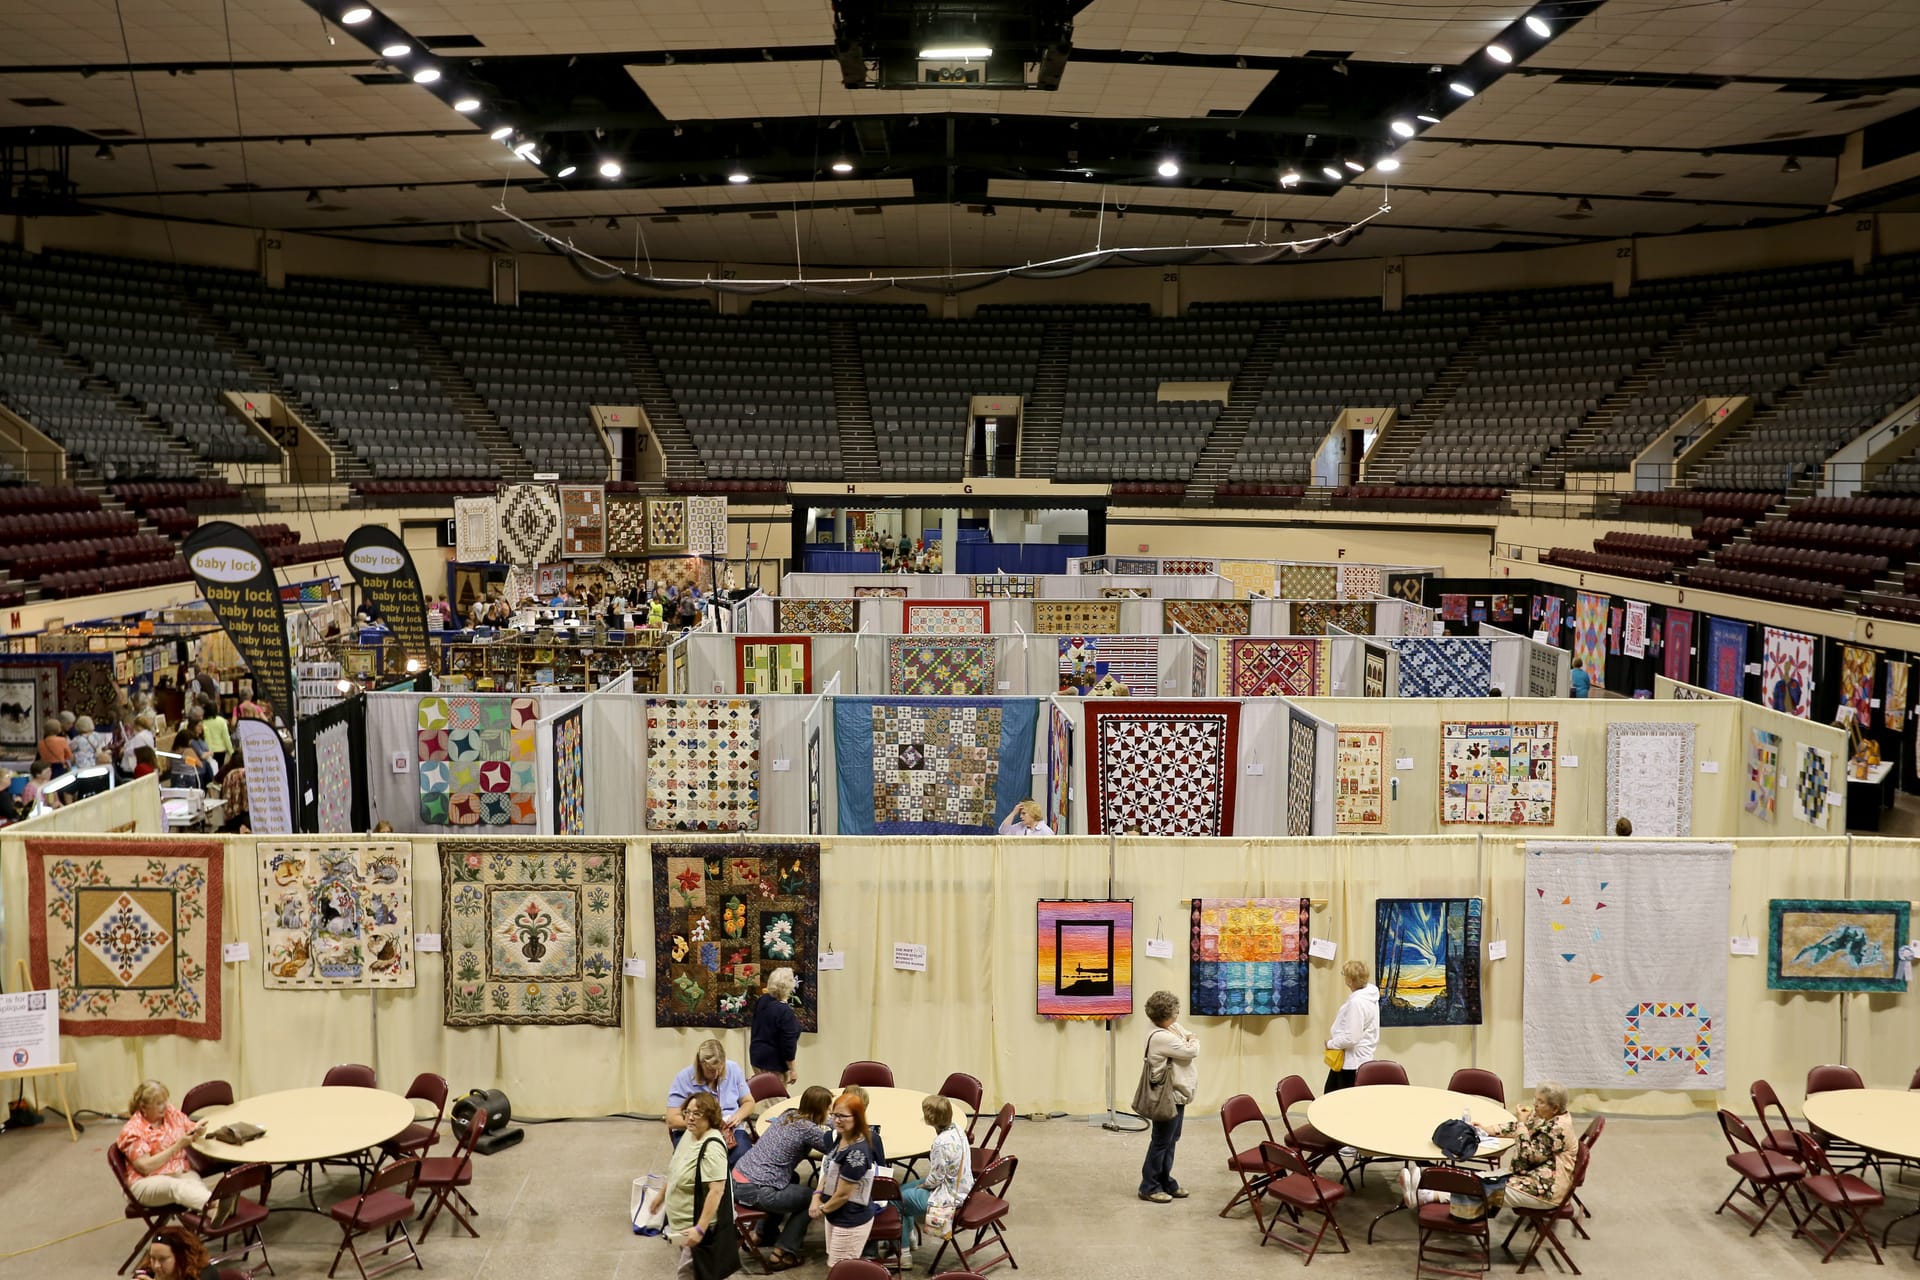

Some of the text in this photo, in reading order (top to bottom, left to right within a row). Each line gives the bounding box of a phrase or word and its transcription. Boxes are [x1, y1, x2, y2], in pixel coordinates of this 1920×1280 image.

[1856, 220, 1872, 231] 20
[266, 239, 281, 249] 23
[1616, 247, 1631, 258] 22
[498, 258, 513, 269] 25
[1387, 263, 1401, 274] 24
[1163, 272, 1177, 282] 26
[847, 484, 855, 494] H
[964, 484, 973, 494] G
[1337, 549, 1345, 559] F
[196, 556, 257, 572] baby lock
[354, 554, 401, 566] baby lock
[363, 577, 414, 590] baby lock
[207, 586, 273, 603] baby lock
[372, 591, 418, 602] baby lock
[1678, 590, 1684, 604] D
[219, 605, 276, 619] baby lock
[380, 604, 420, 614] baby lock
[10, 611, 21, 630] M
[387, 615, 422, 624] baby lock
[229, 621, 279, 633] baby lock
[1865, 621, 1874, 640] C
[238, 635, 281, 647] baby lock
